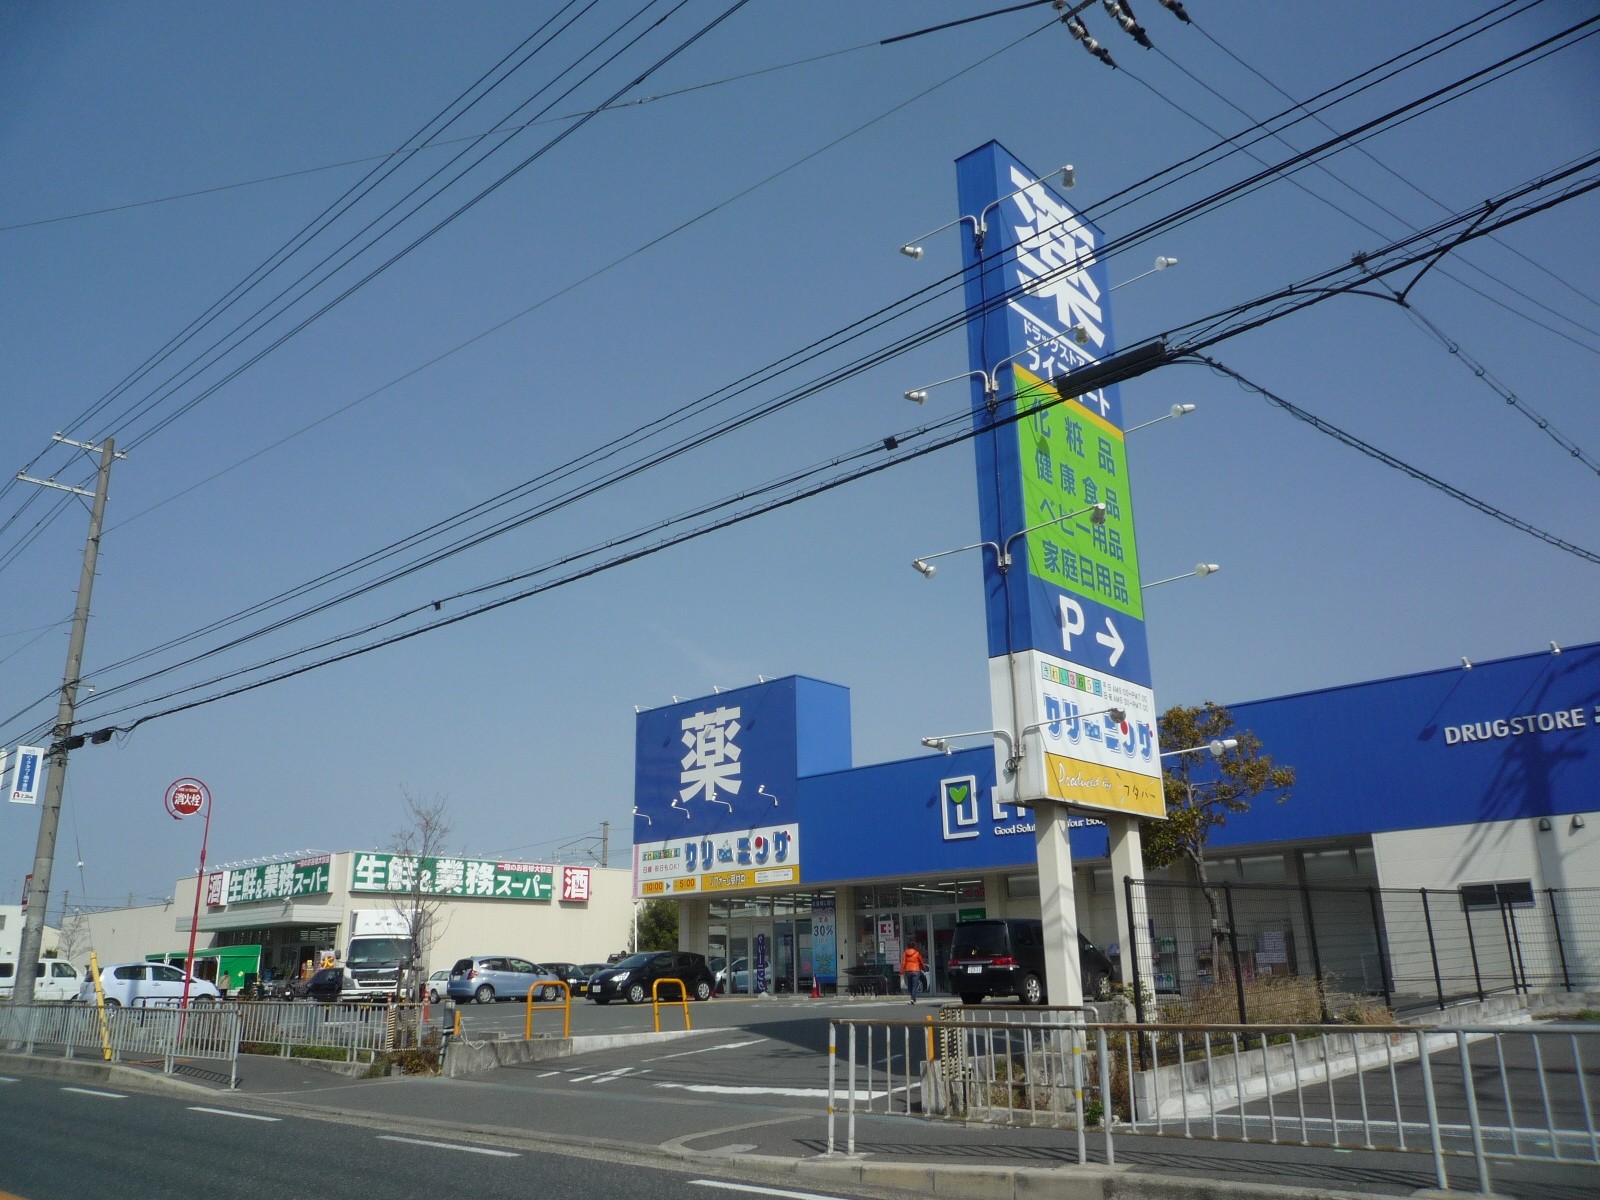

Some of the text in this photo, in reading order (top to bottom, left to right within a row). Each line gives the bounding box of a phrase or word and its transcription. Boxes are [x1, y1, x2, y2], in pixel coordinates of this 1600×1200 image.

[1010, 164, 1106, 349] 薬
[1030, 396, 1116, 477] 化粧品
[1034, 449, 1121, 521] 健康食品
[1040, 496, 1125, 562] ベビー用品
[1042, 538, 1129, 606] 家庭日用品
[1059, 594, 1085, 652] P
[1444, 708, 1586, 744] DRUGSTORE
[679, 706, 742, 802] 薬
[174, 793, 201, 806] 消火栓
[685, 830, 792, 872] クリーニング
[994, 825, 1016, 836] Good
[207, 874, 222, 904] 酒
[228, 863, 329, 903] 生鮮&業務スーパー
[354, 854, 552, 897] 生鮮&業務スーパー
[564, 868, 589, 899] 酒
[813, 925, 834, 937] 30%
